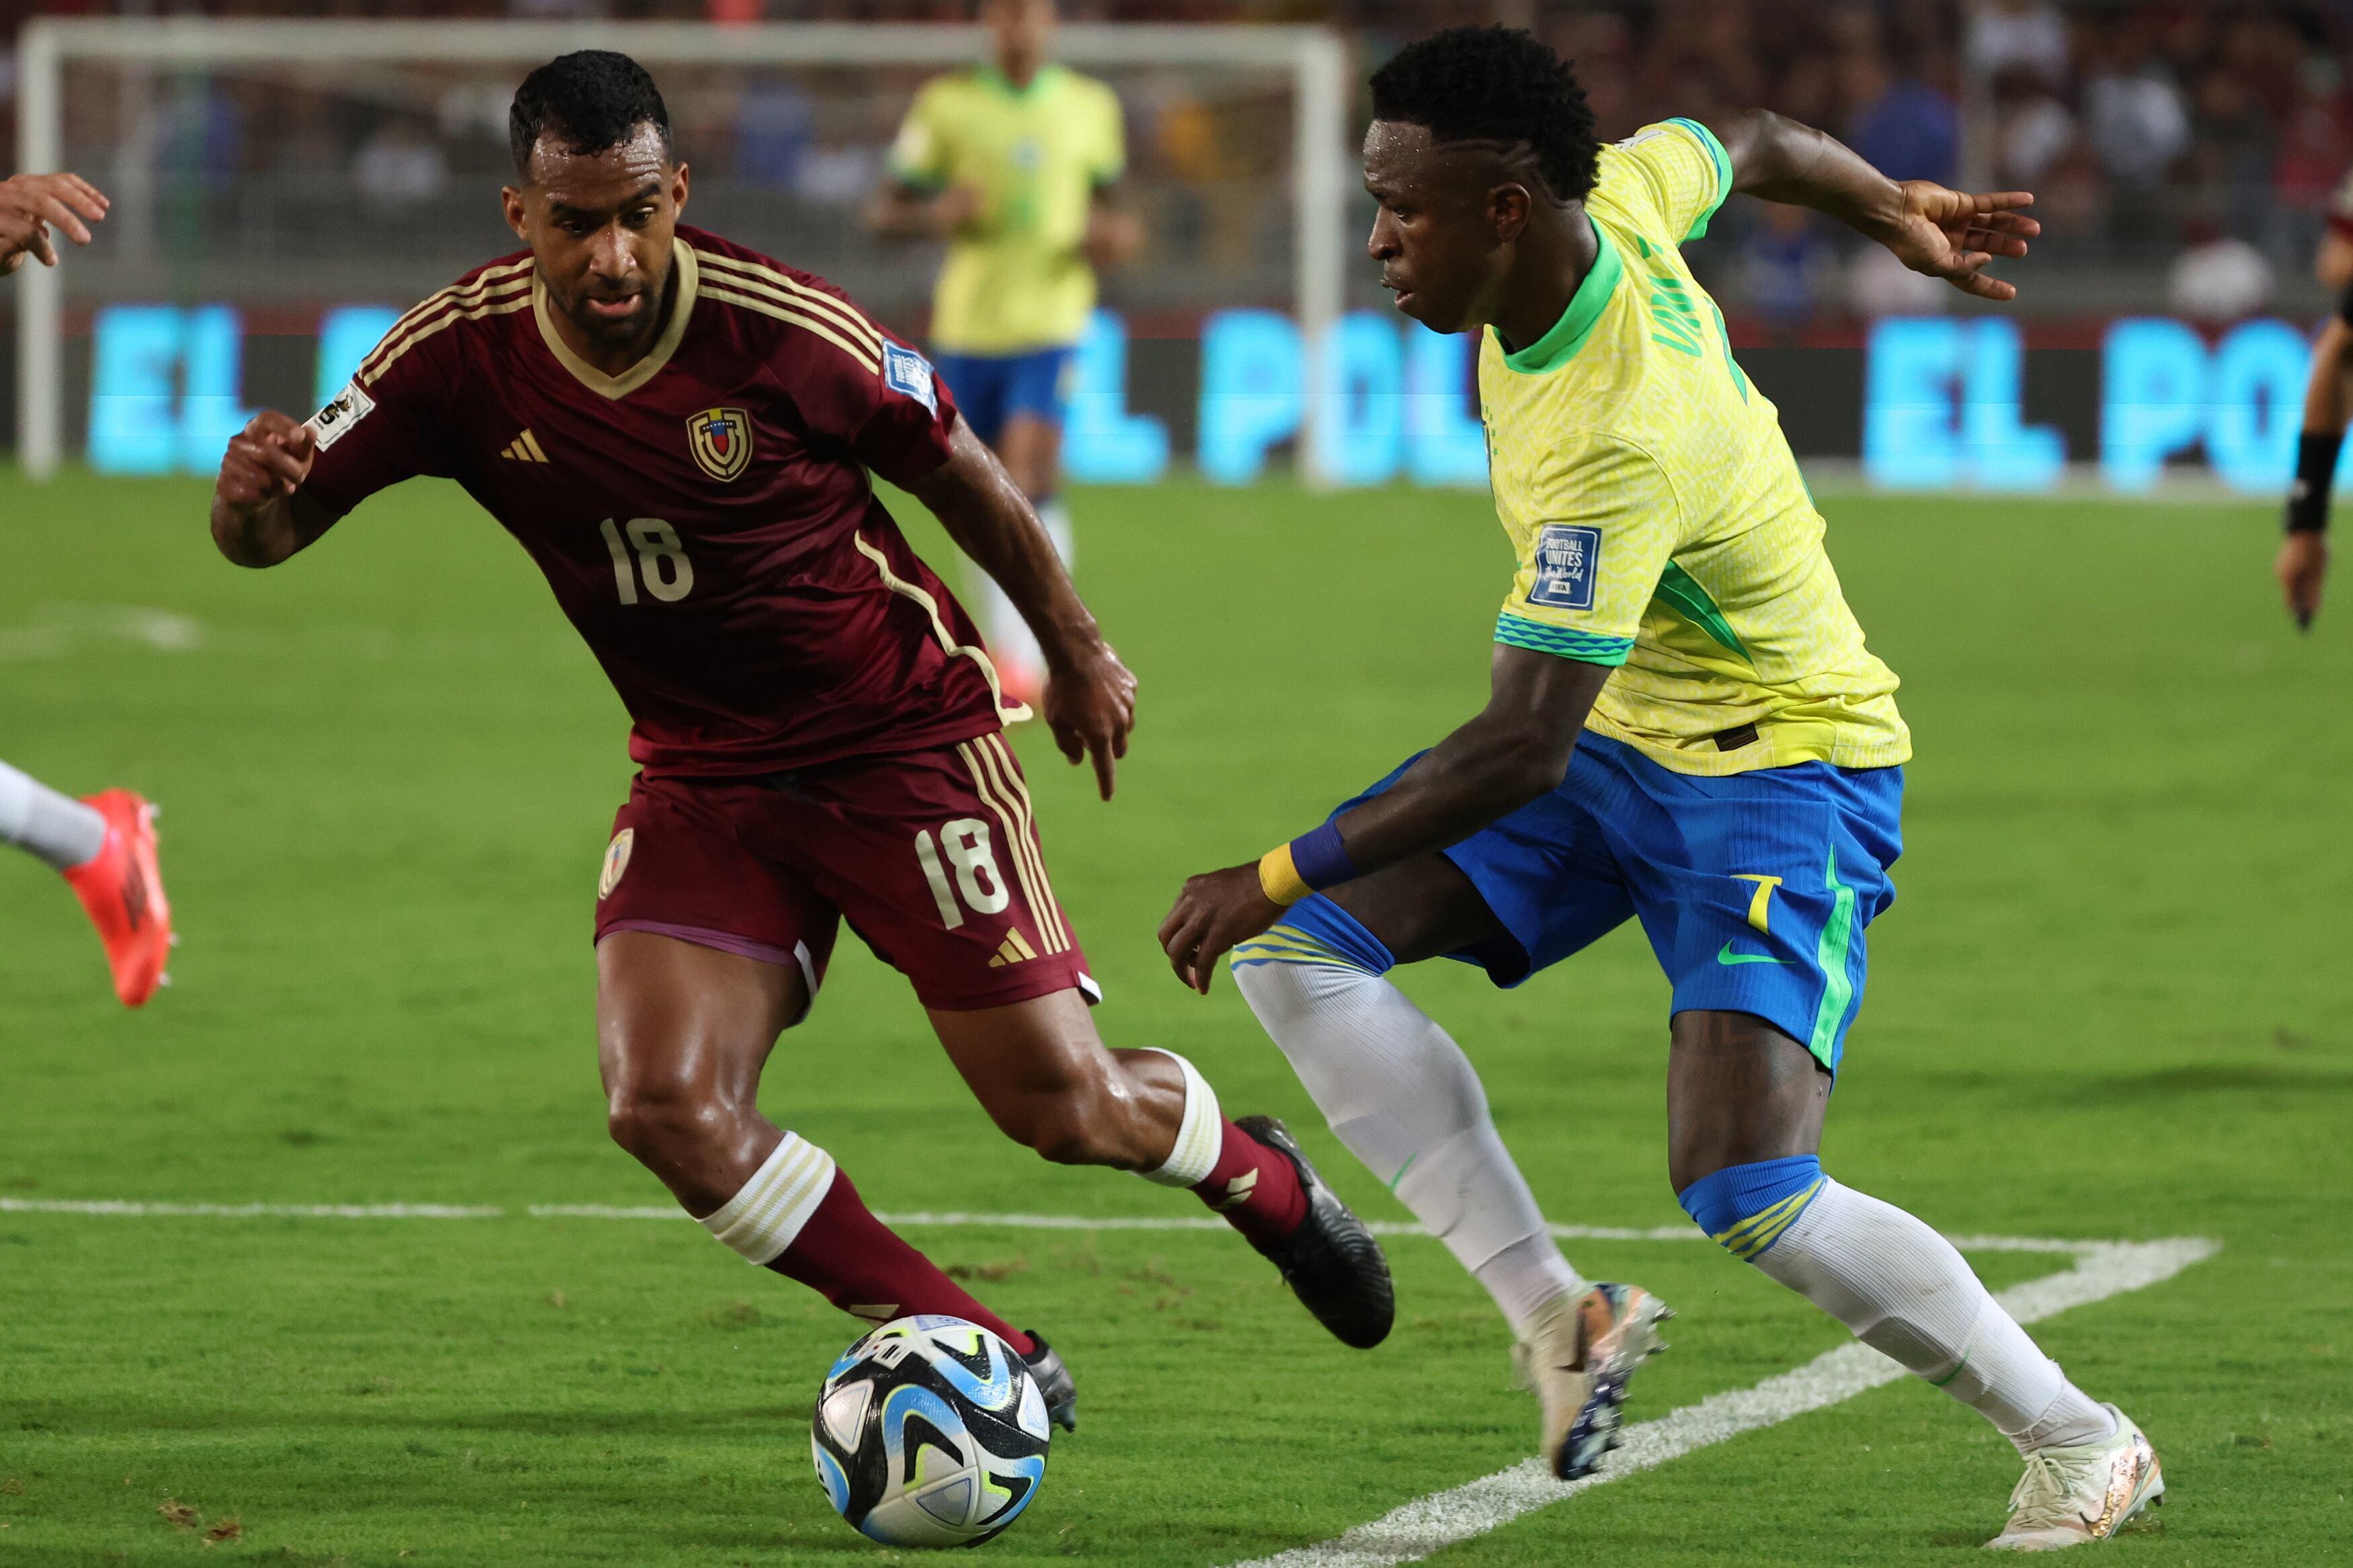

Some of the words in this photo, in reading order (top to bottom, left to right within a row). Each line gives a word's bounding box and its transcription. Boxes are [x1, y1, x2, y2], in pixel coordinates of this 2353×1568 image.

[89, 304, 262, 475] EL
[1061, 306, 1171, 484] L
[1864, 317, 2065, 489] EL
[2102, 317, 2353, 491] PO
[599, 517, 694, 606] 18
[1546, 538, 1583, 551] FOOTBALL
[1546, 550, 1583, 567] UNITES
[914, 818, 1009, 930] 18
[1730, 874, 1783, 935] 7
